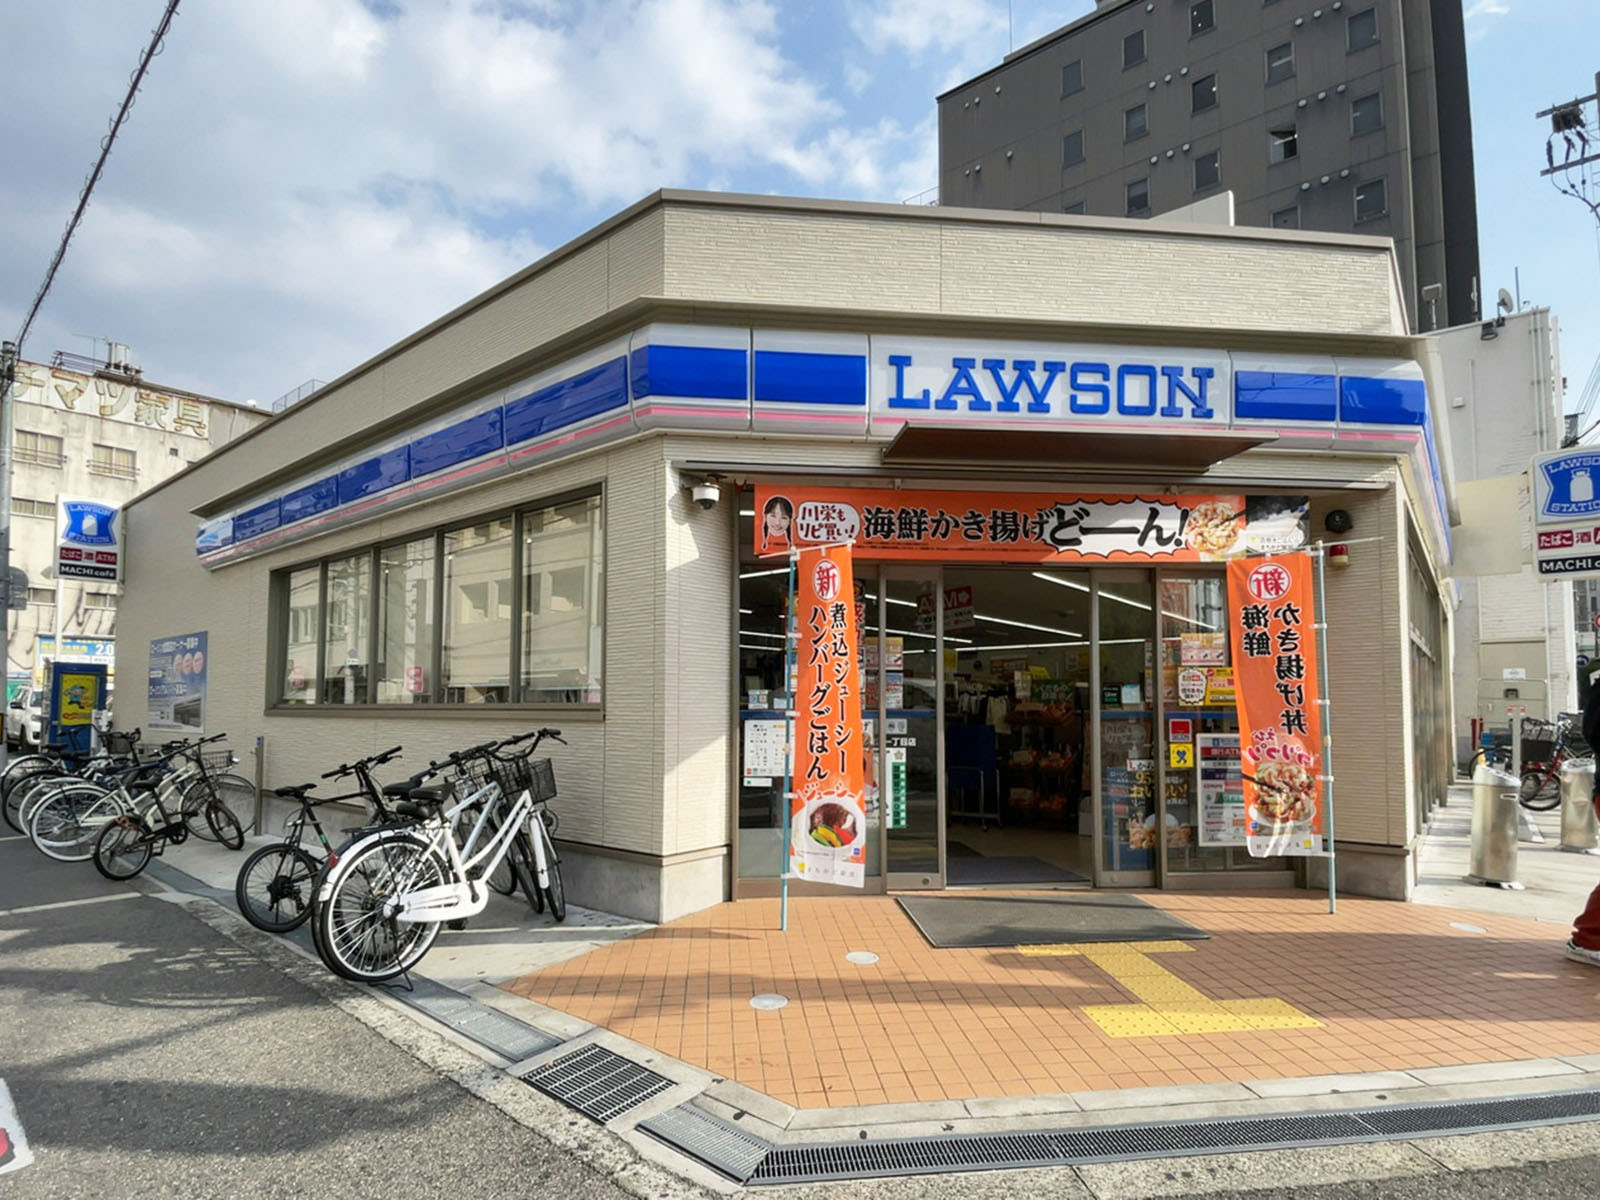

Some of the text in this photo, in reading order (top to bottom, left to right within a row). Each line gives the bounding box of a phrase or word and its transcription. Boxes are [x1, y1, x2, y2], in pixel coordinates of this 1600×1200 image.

[888, 355, 1214, 419] LAWSON
[801, 504, 847, 522] 川栄も
[1540, 533, 1572, 548] たばこ
[96, 553, 116, 562] ATM
[1541, 559, 1592, 572] MACHI
[60, 566, 94, 576] MACHI
[815, 566, 838, 597] 新
[807, 605, 831, 780] ハンバーグごはん
[830, 602, 853, 775] 煮込ジューシー
